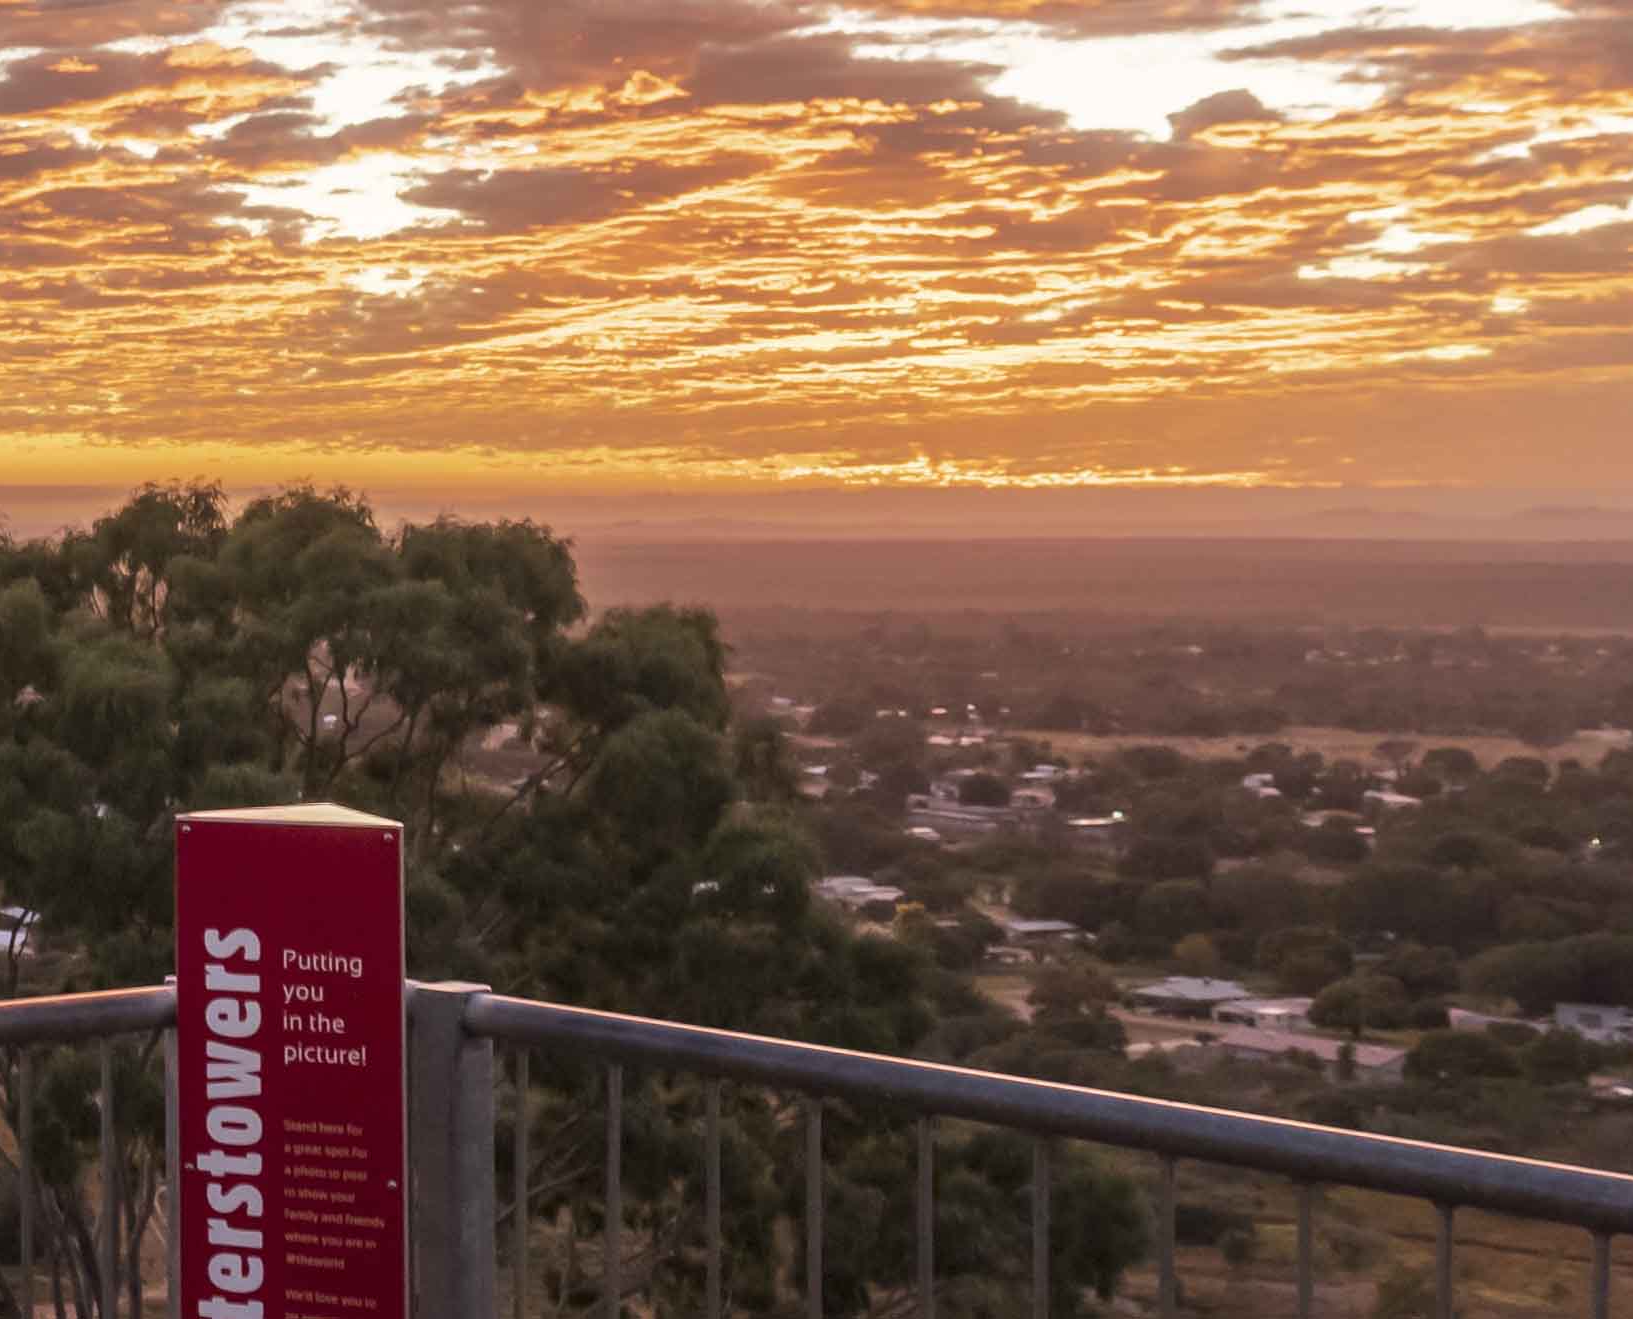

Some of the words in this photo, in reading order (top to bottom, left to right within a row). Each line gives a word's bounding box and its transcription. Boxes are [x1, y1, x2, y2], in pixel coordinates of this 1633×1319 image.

[282, 949, 363, 978] Putting
[282, 983, 325, 1005] you
[282, 1009, 303, 1031] in
[308, 1011, 347, 1035] the
[283, 1043, 367, 1068] picture!
